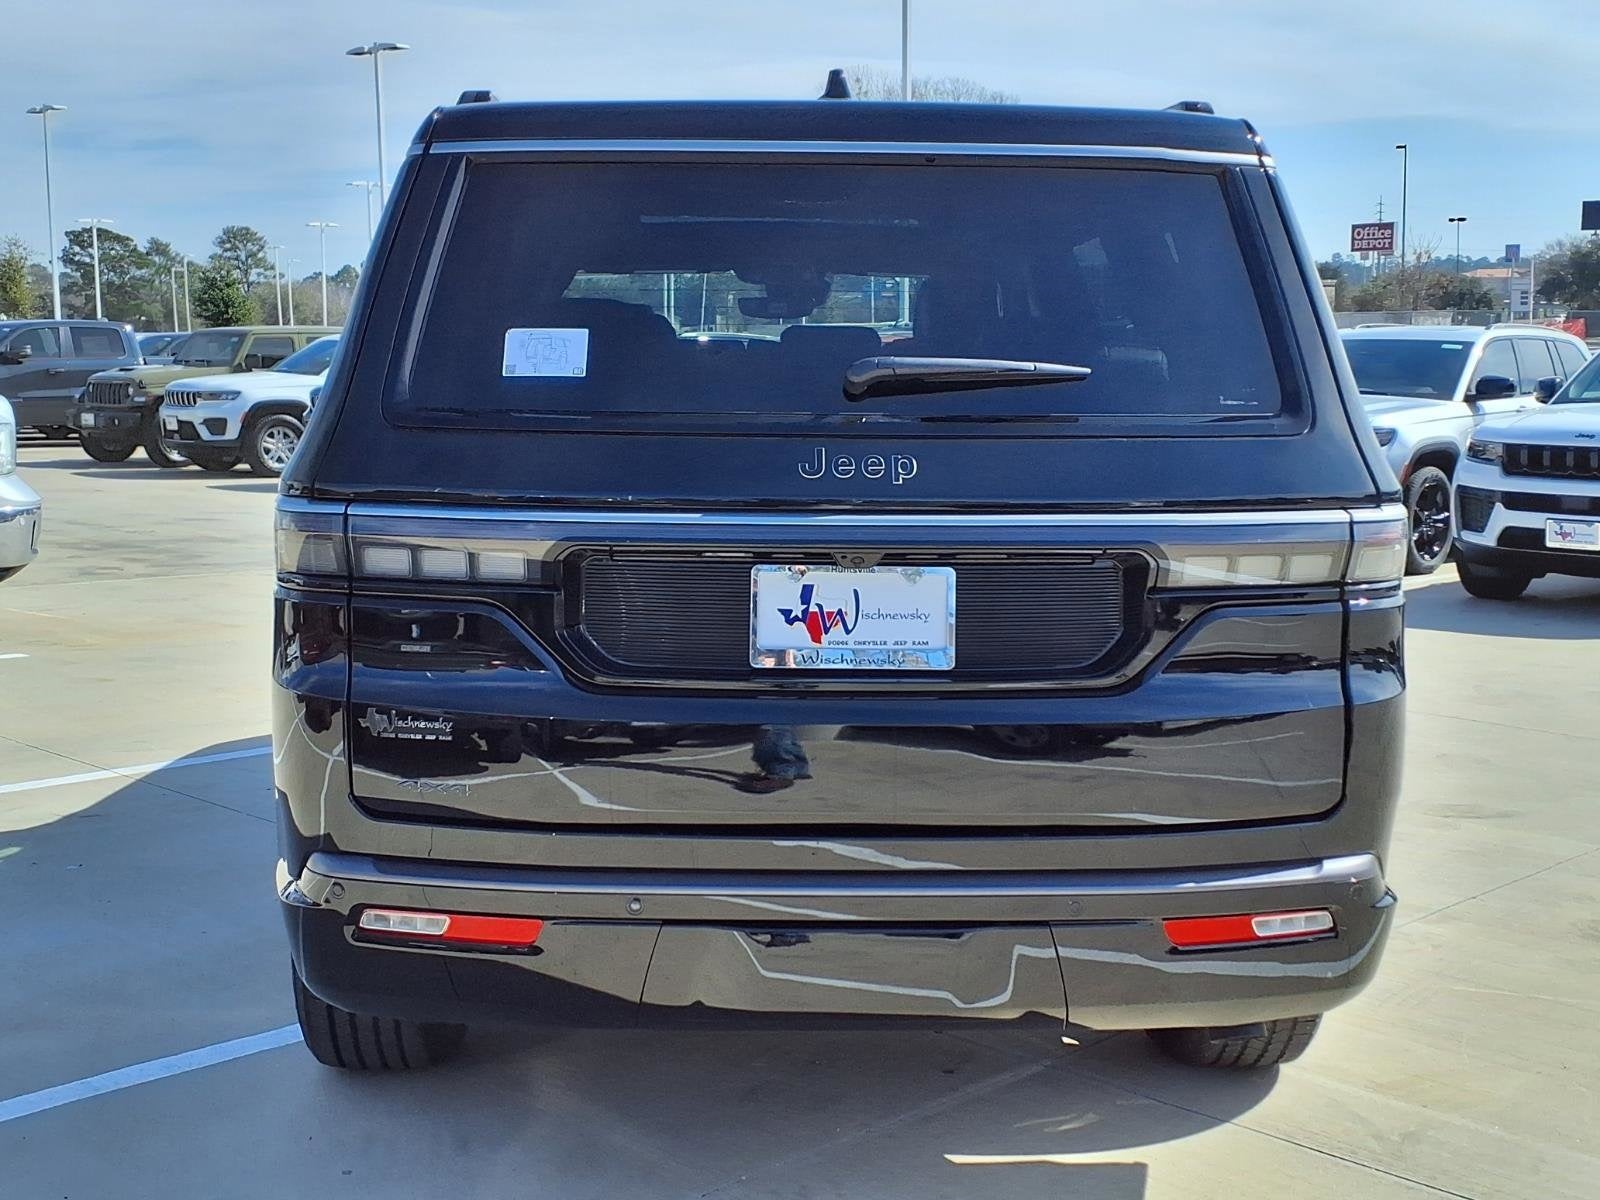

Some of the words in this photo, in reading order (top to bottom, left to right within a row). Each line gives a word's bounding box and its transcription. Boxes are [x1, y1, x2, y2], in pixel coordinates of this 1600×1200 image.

[1354, 227, 1392, 239] Office
[1354, 239, 1391, 248] DEPOT
[798, 447, 918, 485] Jeep
[801, 650, 905, 666] Wischnewsky
